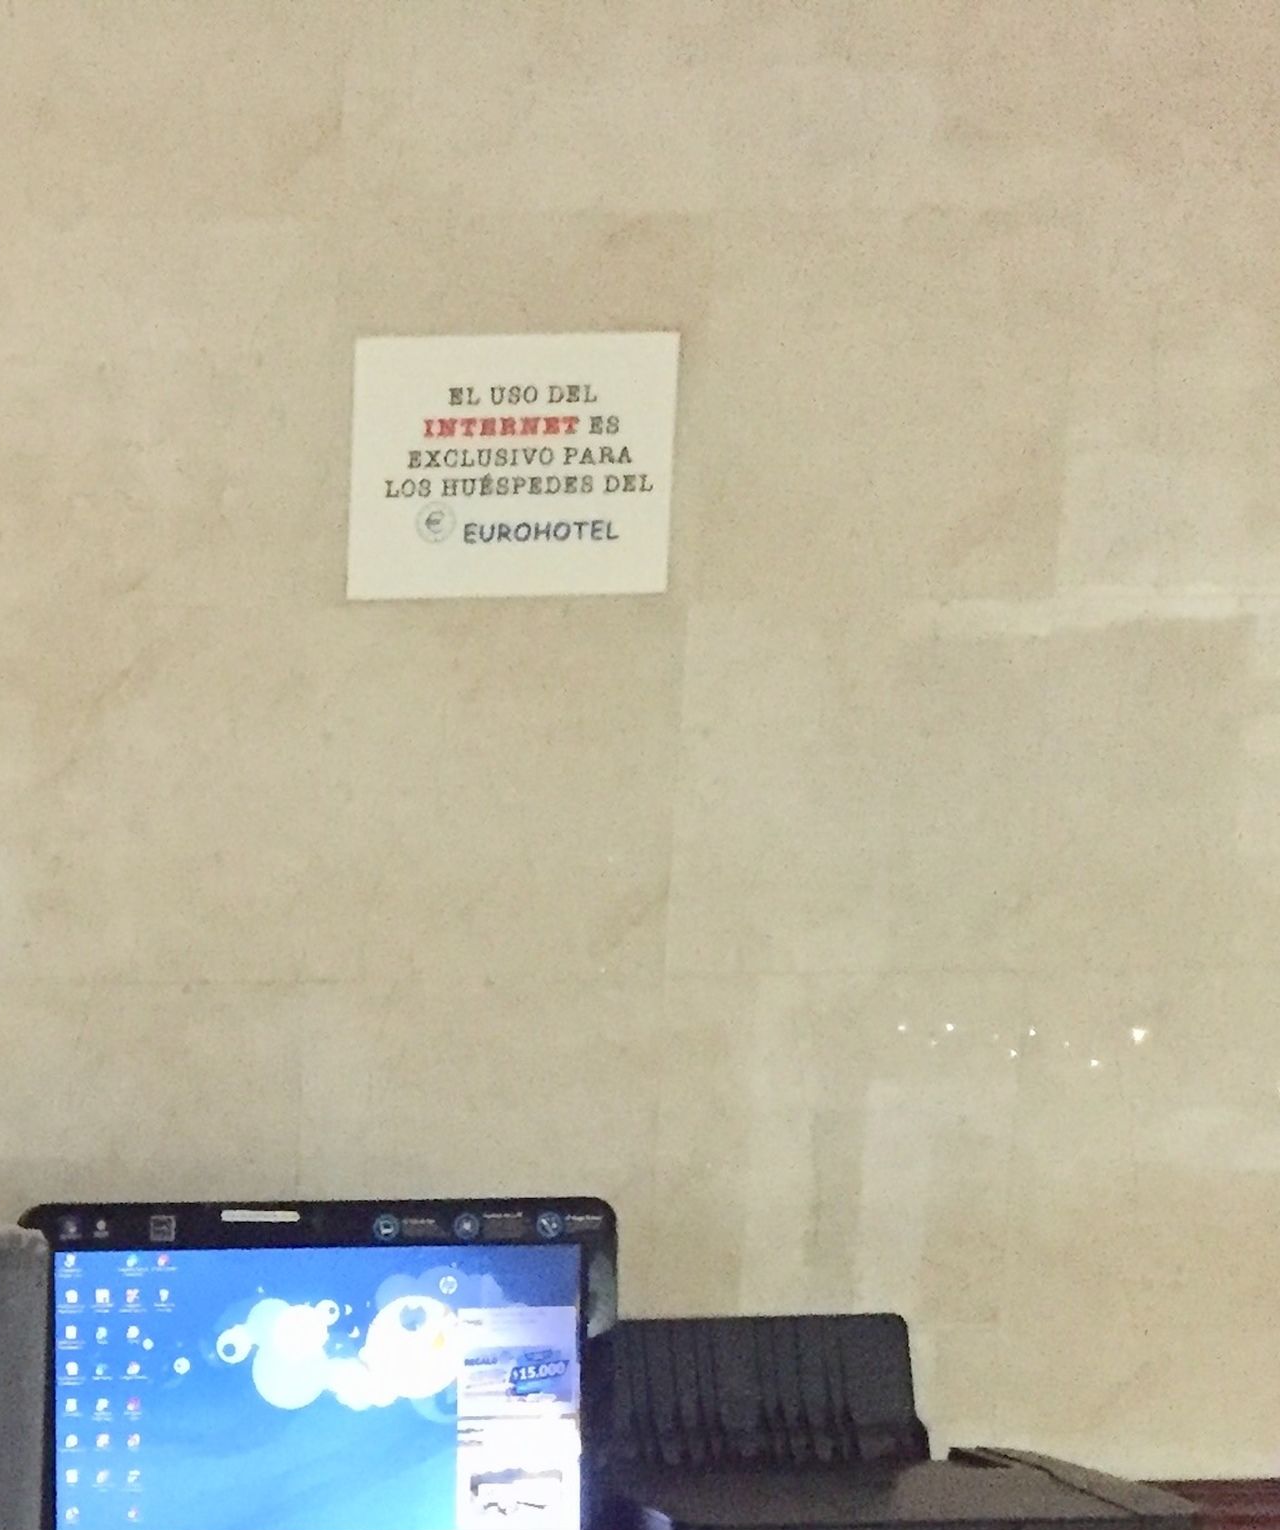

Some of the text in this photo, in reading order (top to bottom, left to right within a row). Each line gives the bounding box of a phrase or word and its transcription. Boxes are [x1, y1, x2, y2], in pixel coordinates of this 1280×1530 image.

[448, 384, 598, 407] EL USO DEL
[423, 415, 620, 439] INTERNET ES
[407, 445, 633, 470] EXCLUSIVO PARA
[384, 472, 654, 499] LOS HUÉSPEDES DEL
[463, 519, 620, 545] EUROHOTEL
